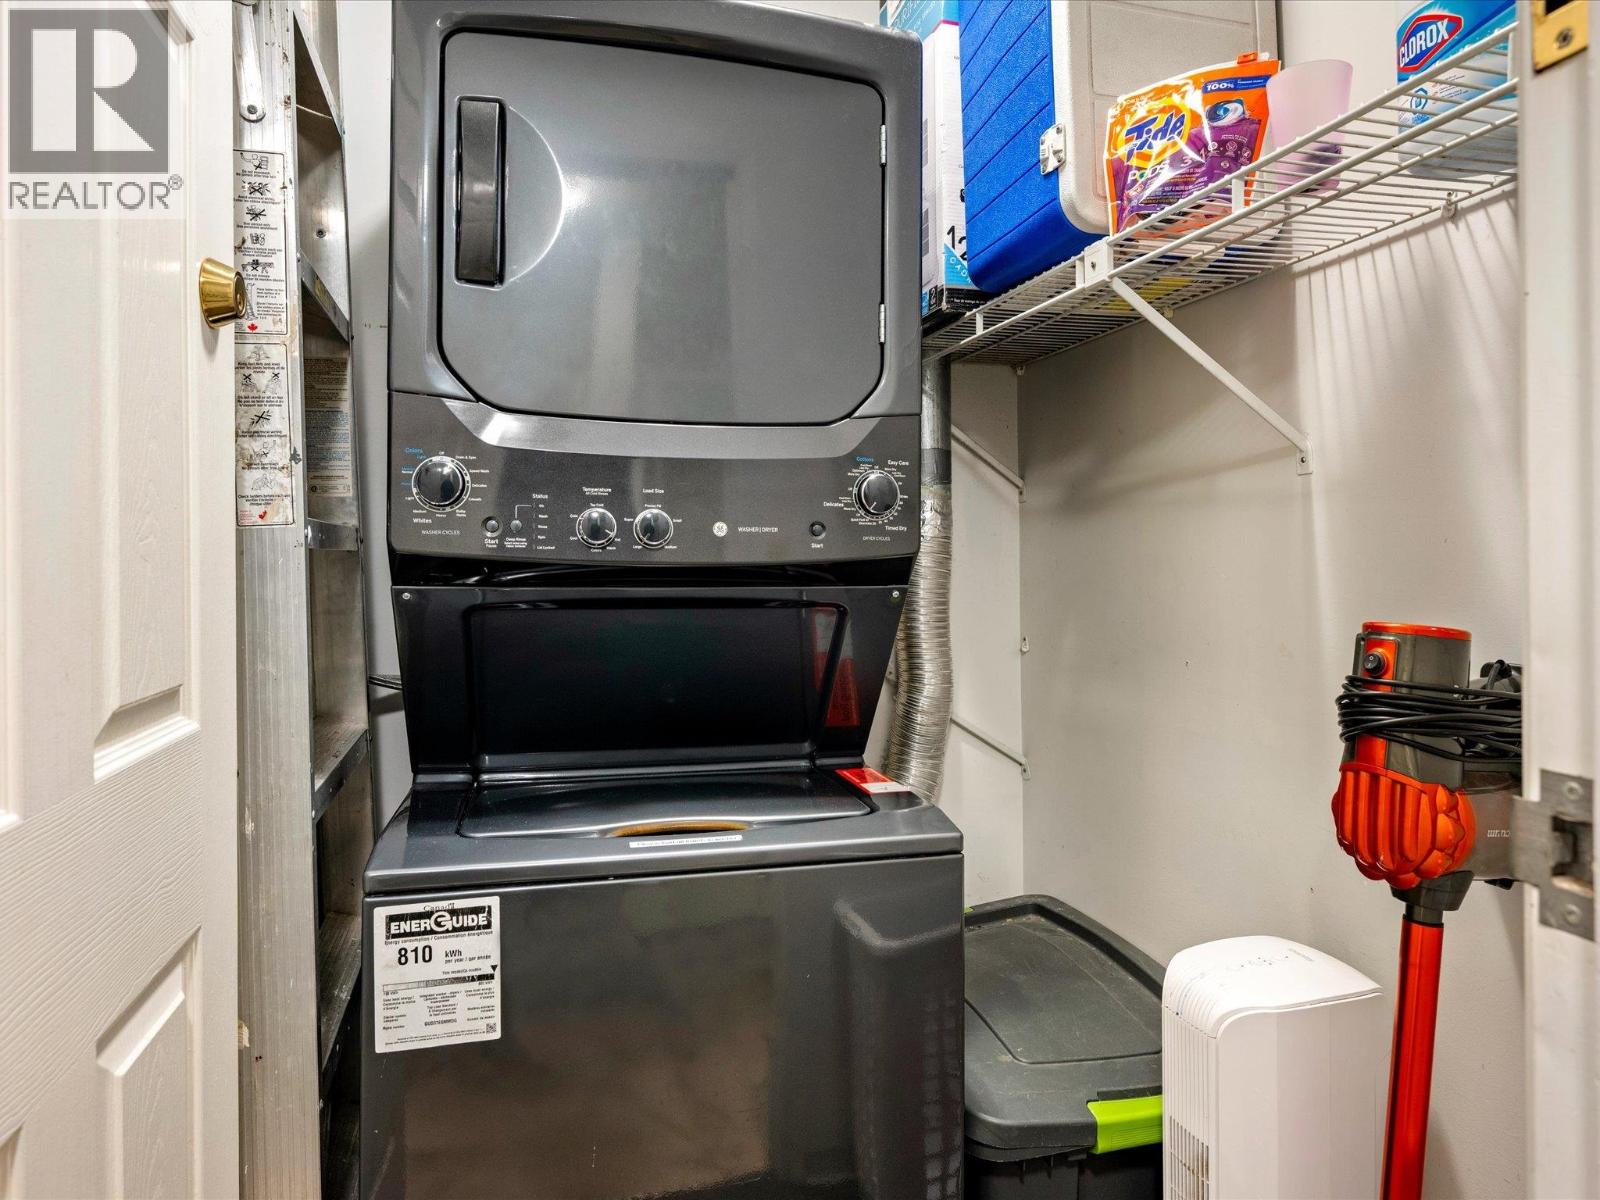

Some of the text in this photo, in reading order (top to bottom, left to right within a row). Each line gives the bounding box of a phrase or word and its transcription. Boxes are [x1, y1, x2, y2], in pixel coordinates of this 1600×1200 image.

[1400, 18, 1449, 67] CLOROX
[1207, 82, 1234, 90] 100%
[1125, 111, 1186, 162] Tide
[390, 911, 488, 934] ENERGUIDE
[398, 945, 432, 965] 810
[445, 950, 462, 958] kWh
